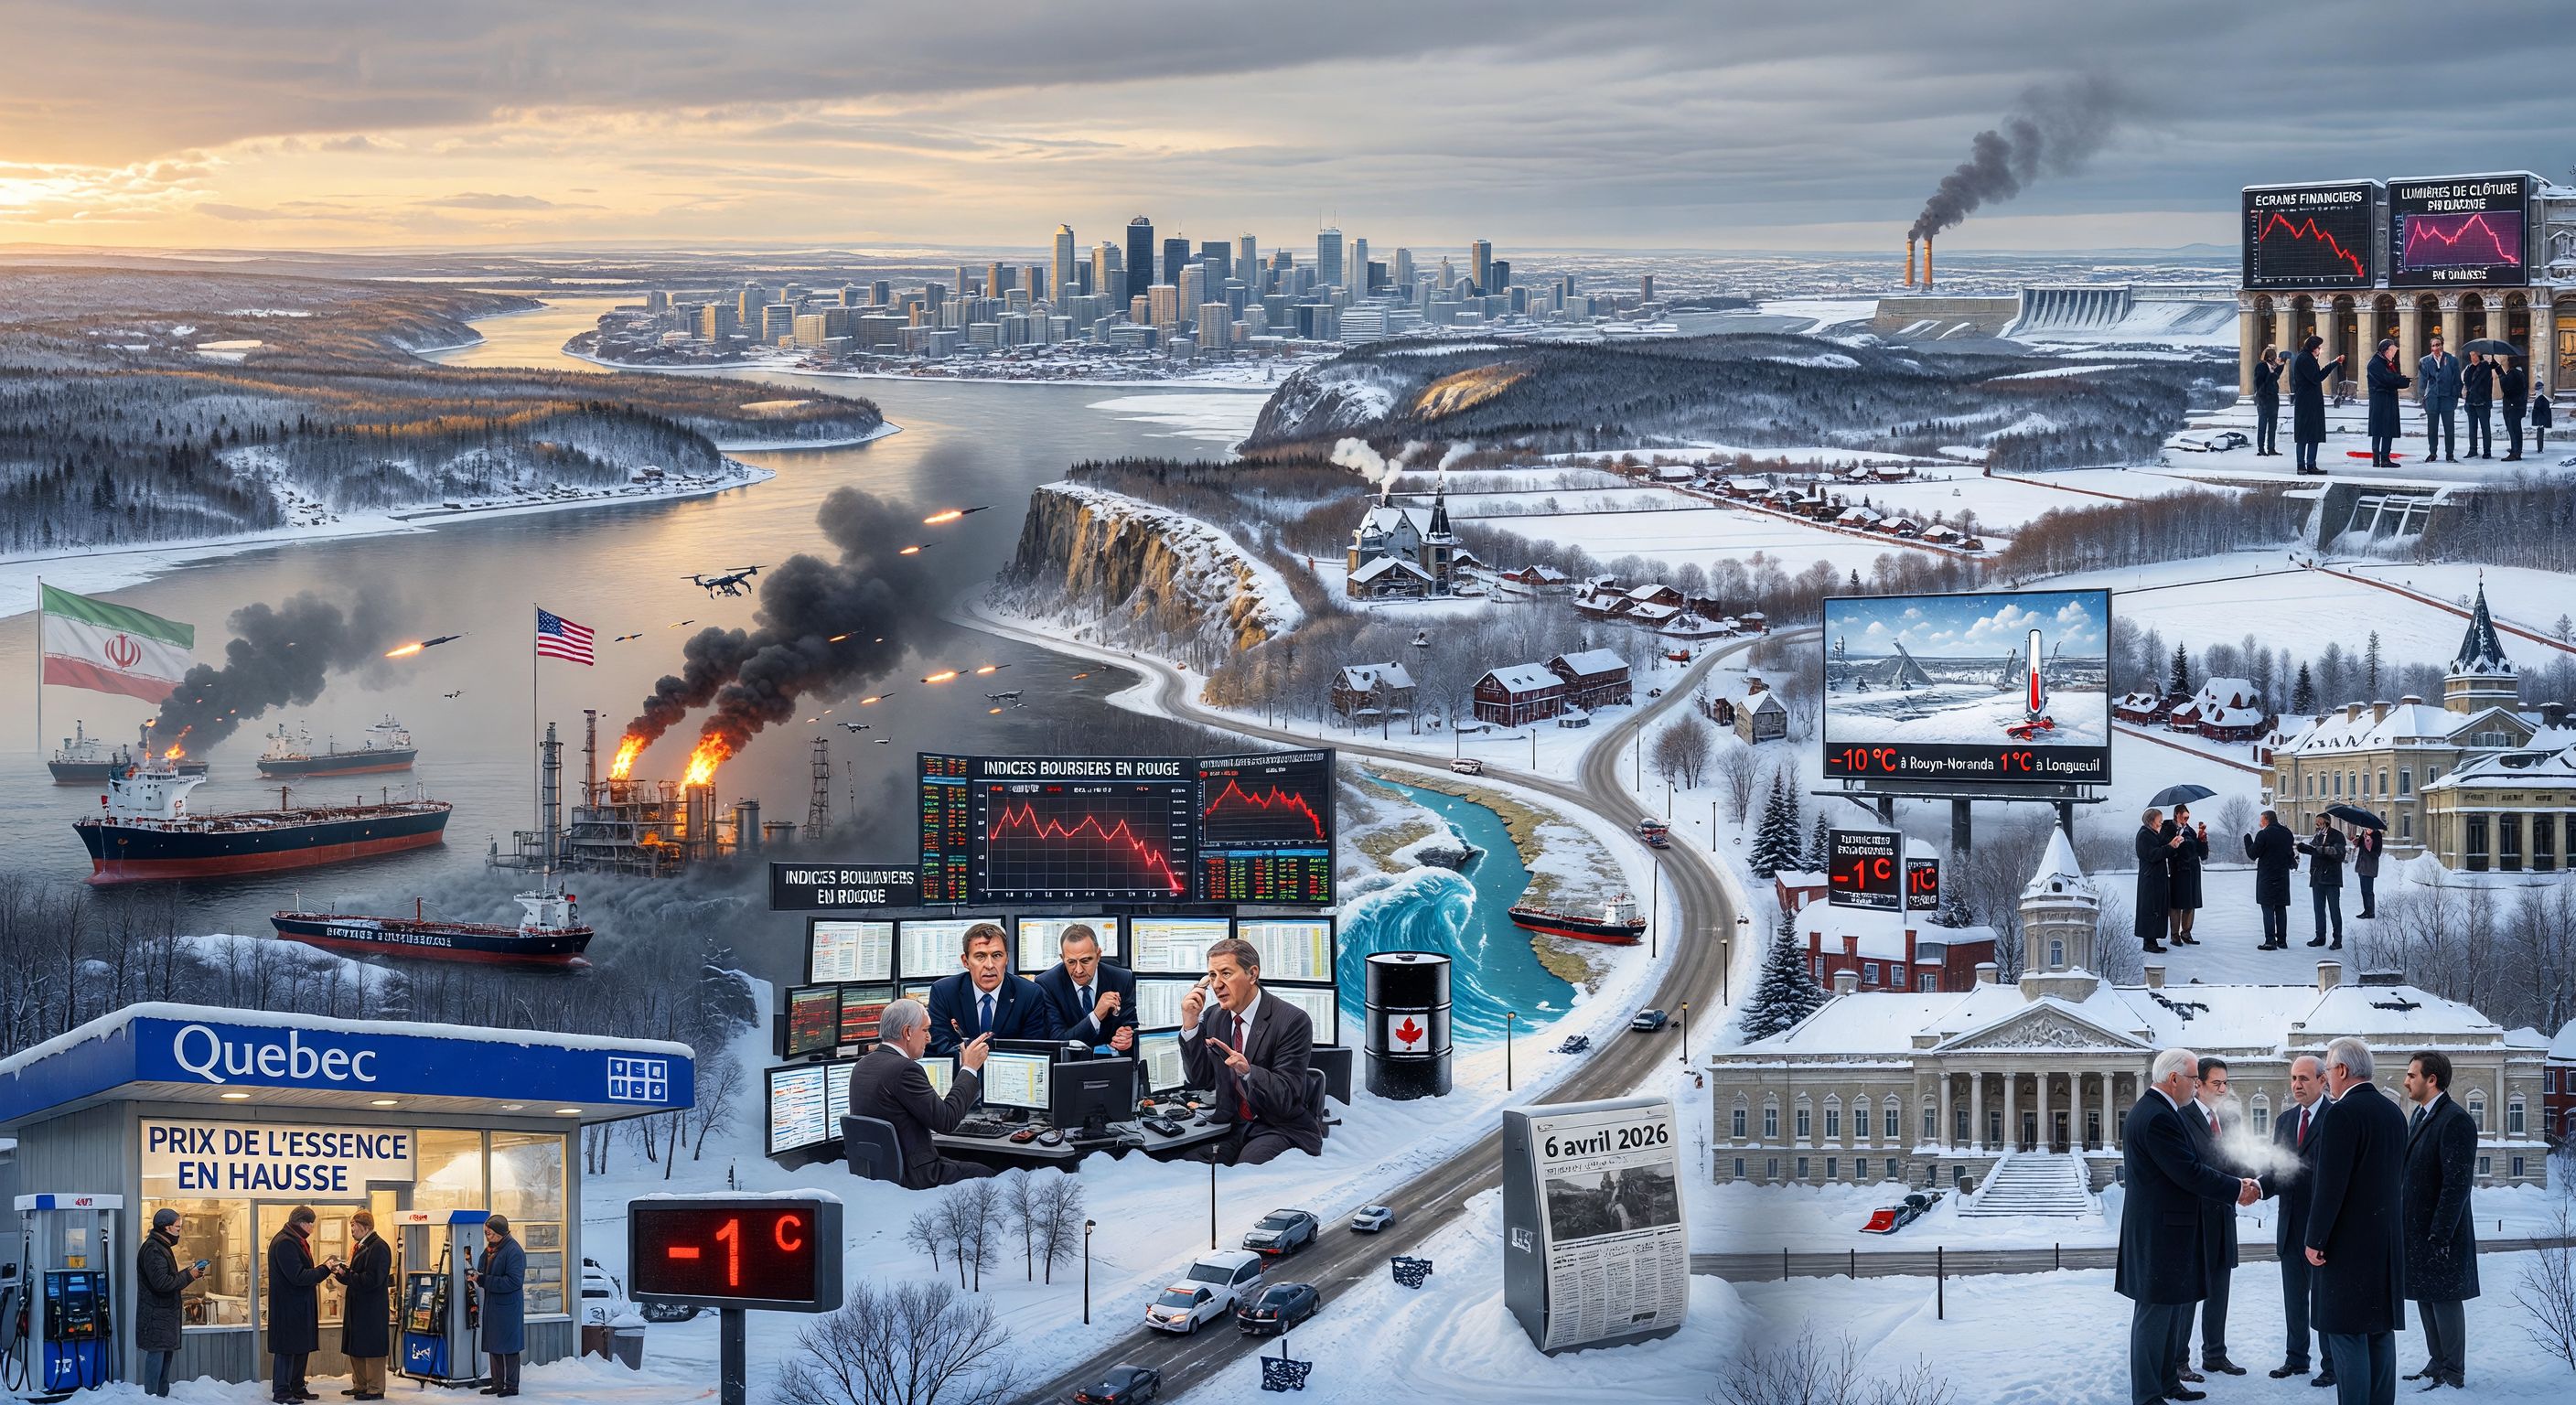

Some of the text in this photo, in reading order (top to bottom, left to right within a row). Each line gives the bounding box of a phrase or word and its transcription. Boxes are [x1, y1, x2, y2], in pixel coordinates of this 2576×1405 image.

[2453, 185, 2467, 197] DE
[984, 761, 1180, 776] INDICES BOURSIERS EN ROUGE
[1830, 748, 1868, 771] -10
[1910, 756, 1994, 773] Rouyn-Noranda
[818, 888, 834, 904] EN
[174, 1024, 377, 1083] Quebec
[149, 1126, 407, 1160] PRIX DE L'ESSENCE
[1545, 1122, 1669, 1158] 6 avril 2026
[178, 1161, 349, 1191] EN HAUSSE
[669, 1219, 738, 1286] -1
